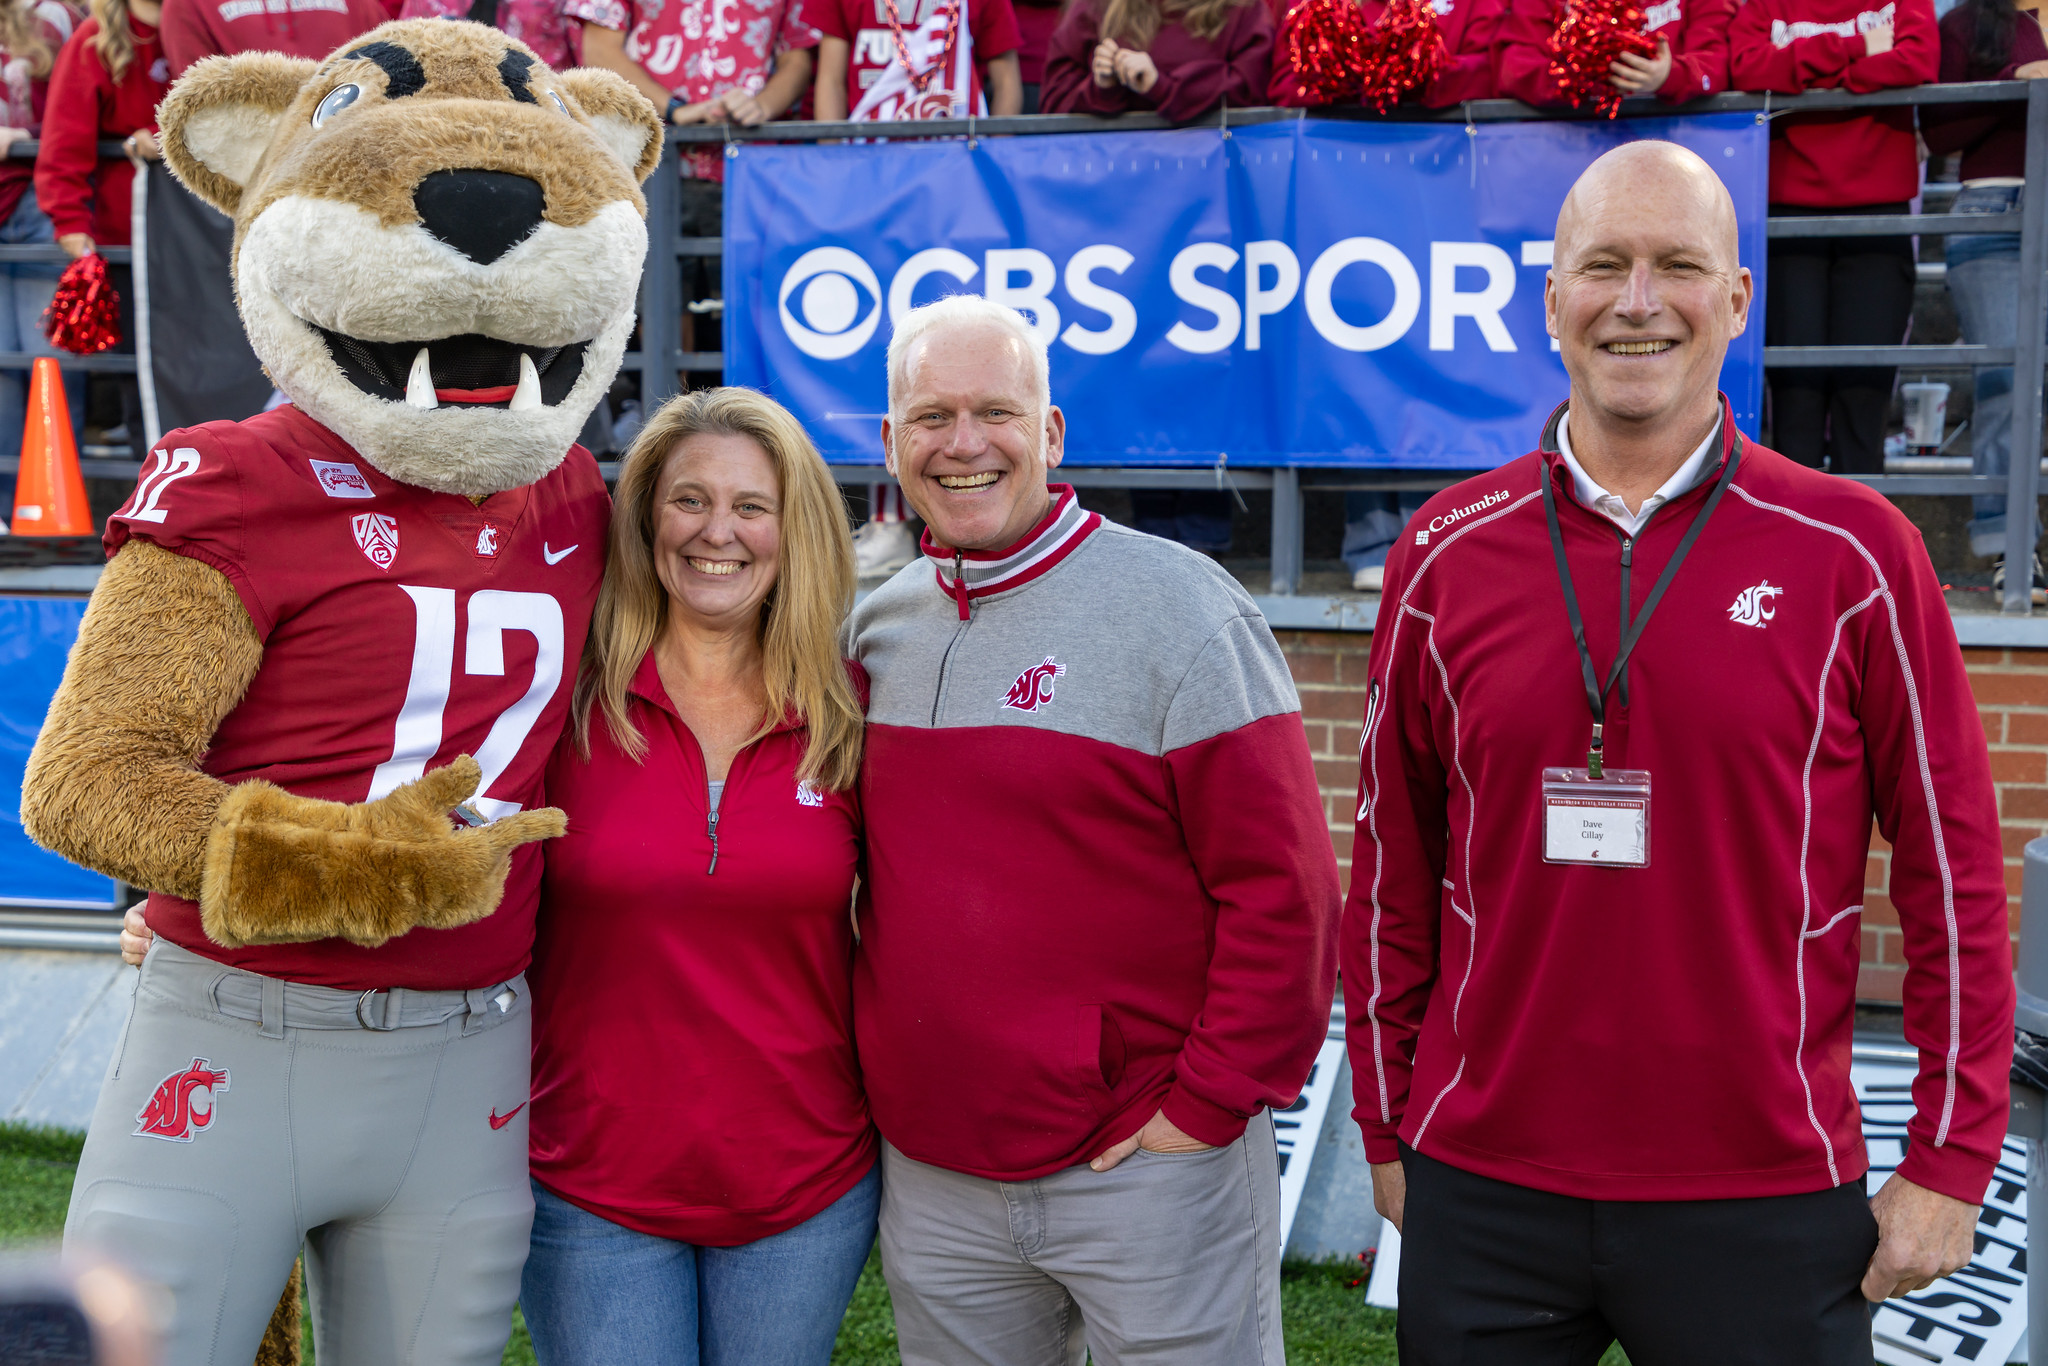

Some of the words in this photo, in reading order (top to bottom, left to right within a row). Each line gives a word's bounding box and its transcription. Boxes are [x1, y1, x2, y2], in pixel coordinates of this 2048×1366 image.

[888, 244, 1137, 354] CBS
[113, 448, 201, 524] 12
[351, 512, 399, 550] PAC
[1429, 490, 1510, 532] Columbia
[374, 550, 390, 562] 12
[366, 584, 565, 826] 12
[1581, 830, 1604, 841] Cillay
[1582, 820, 1603, 828] Dave
